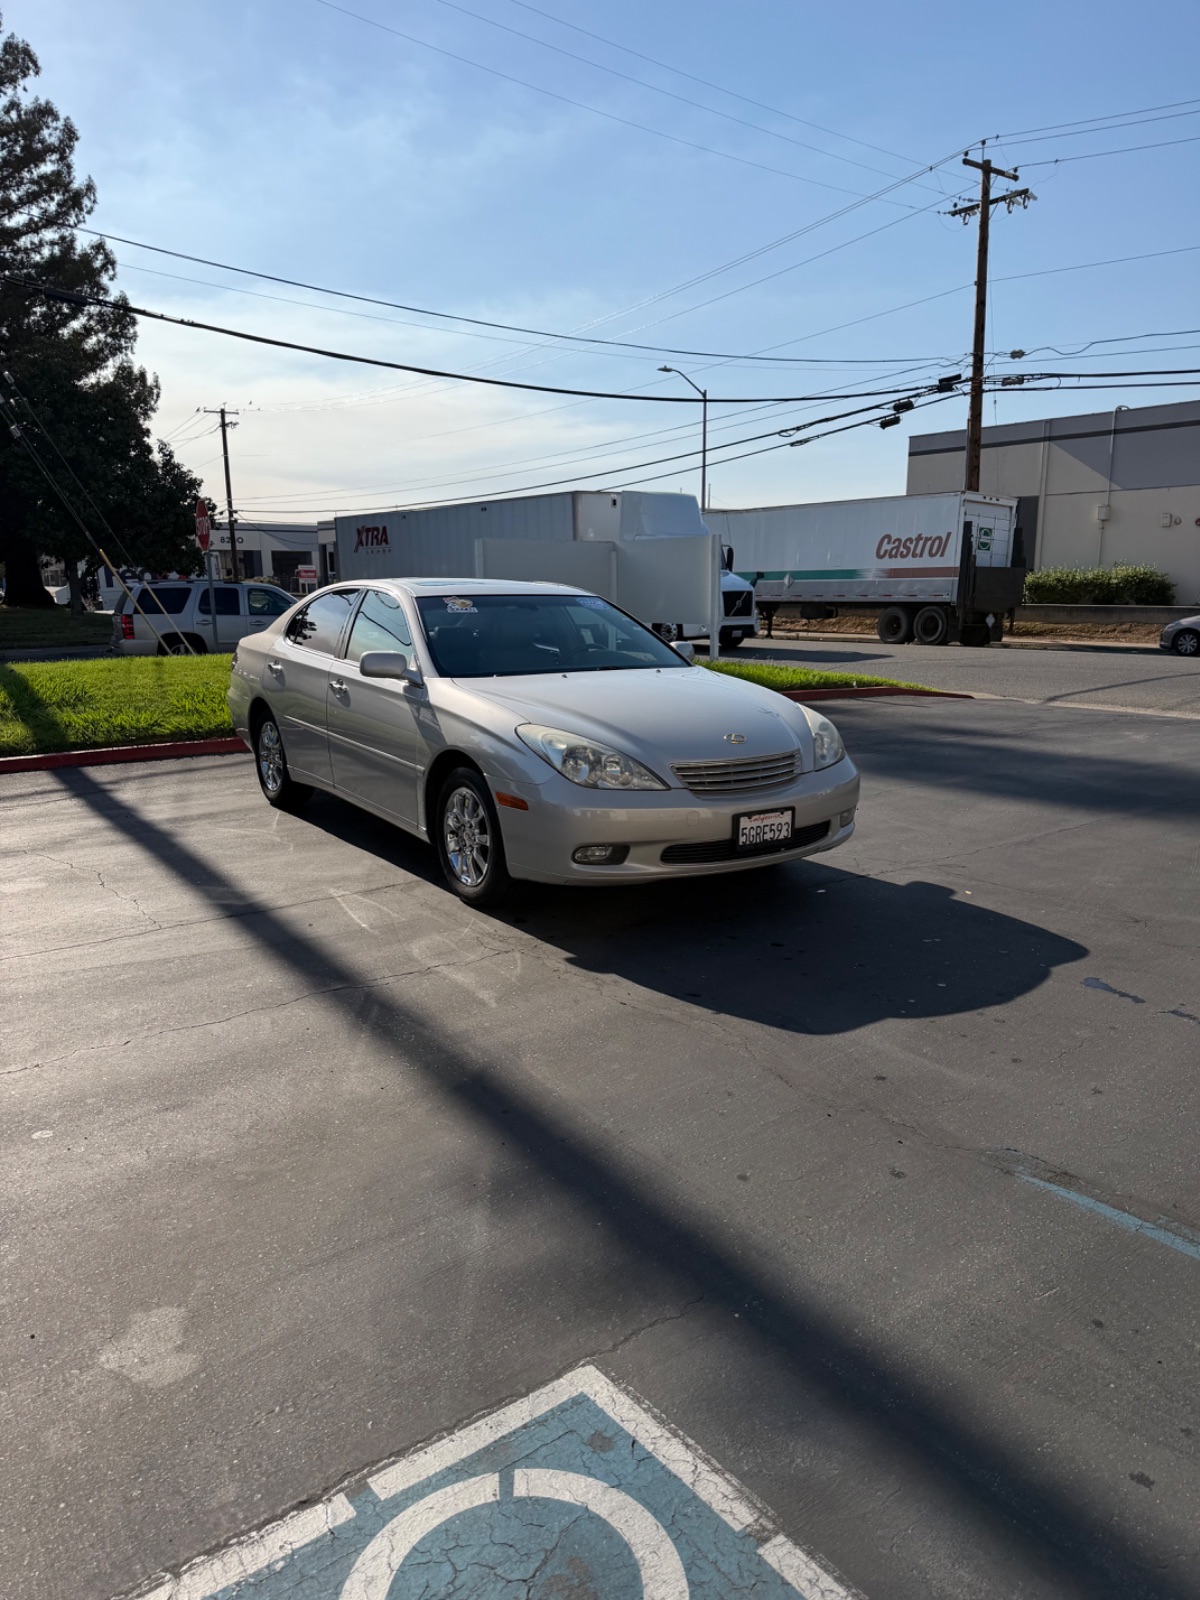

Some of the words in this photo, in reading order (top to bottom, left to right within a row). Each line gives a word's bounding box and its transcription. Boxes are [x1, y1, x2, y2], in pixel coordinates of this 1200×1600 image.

[220, 536, 244, 544] 820
[354, 525, 389, 552] XTRA
[875, 532, 952, 560] Castrol
